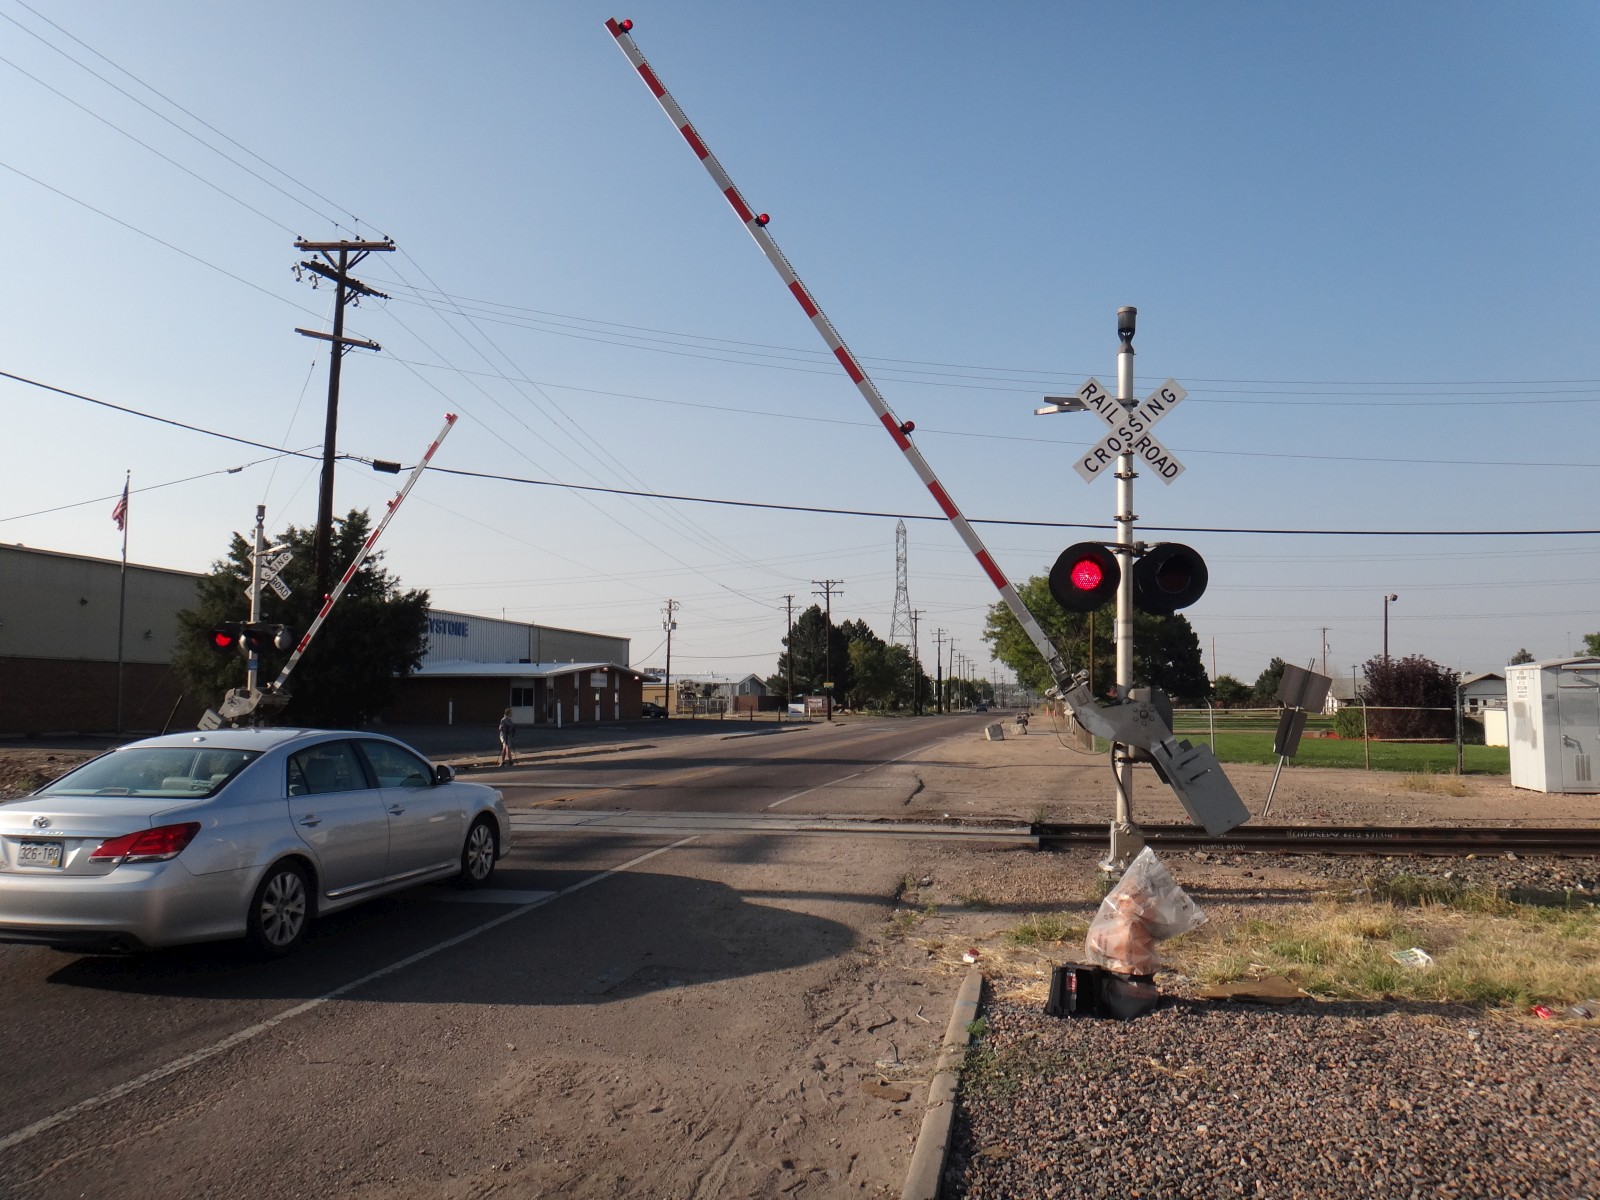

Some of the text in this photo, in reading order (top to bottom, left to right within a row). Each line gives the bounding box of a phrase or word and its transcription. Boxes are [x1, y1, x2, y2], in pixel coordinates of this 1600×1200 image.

[1081, 383, 1178, 478] RAIL ROAD
[1084, 388, 1176, 472] CROSSING
[249, 554, 289, 594] CSSING
[428, 617, 468, 637] YSTONE
